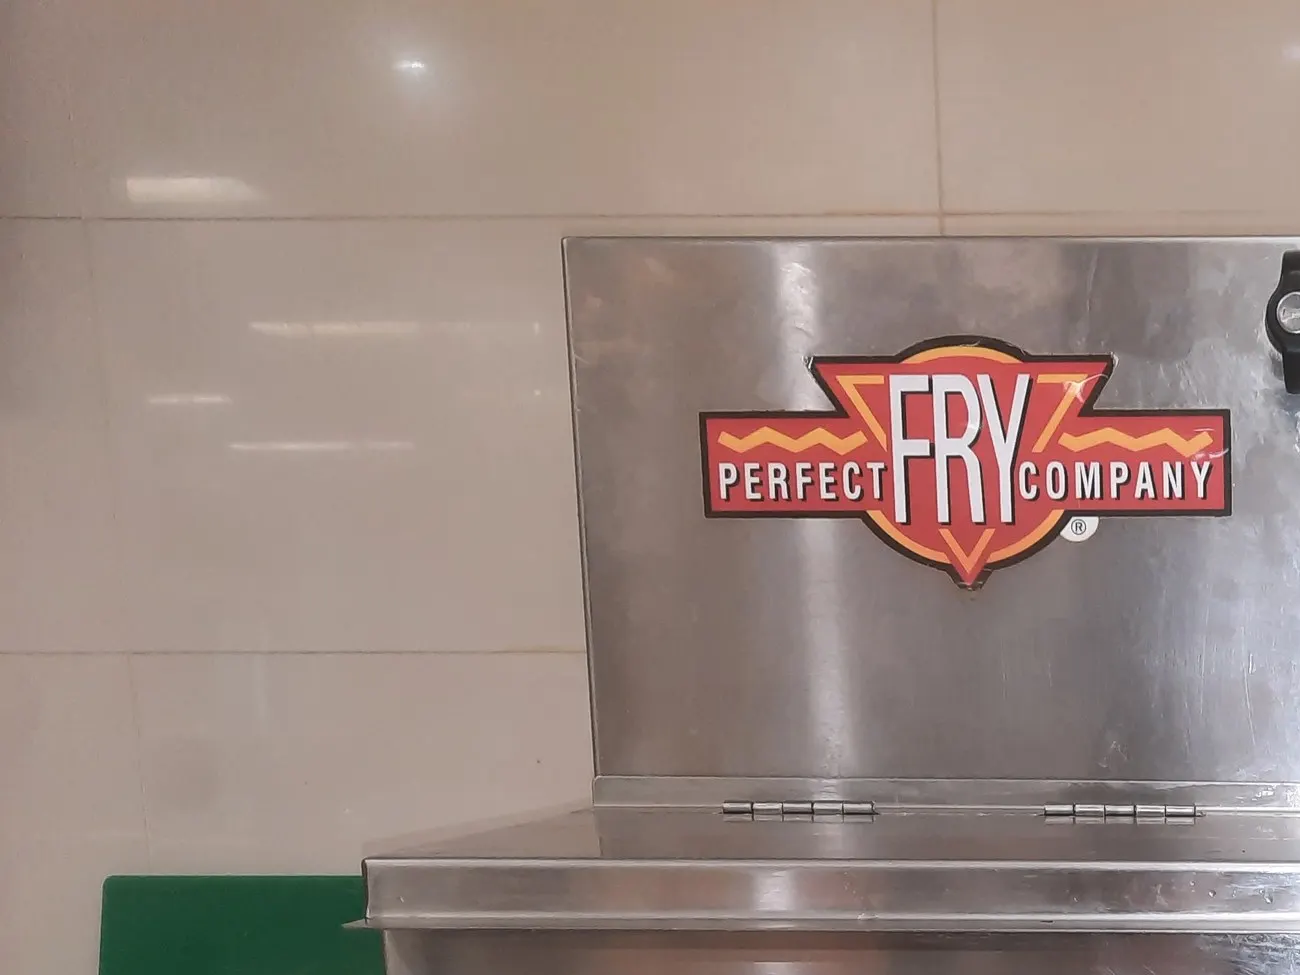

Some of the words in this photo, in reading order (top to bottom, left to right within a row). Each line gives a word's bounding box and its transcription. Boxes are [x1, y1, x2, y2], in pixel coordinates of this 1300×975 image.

[718, 462, 887, 501] PERFECT
[889, 373, 1033, 525] FRY
[1018, 461, 1212, 500] COMPANY
